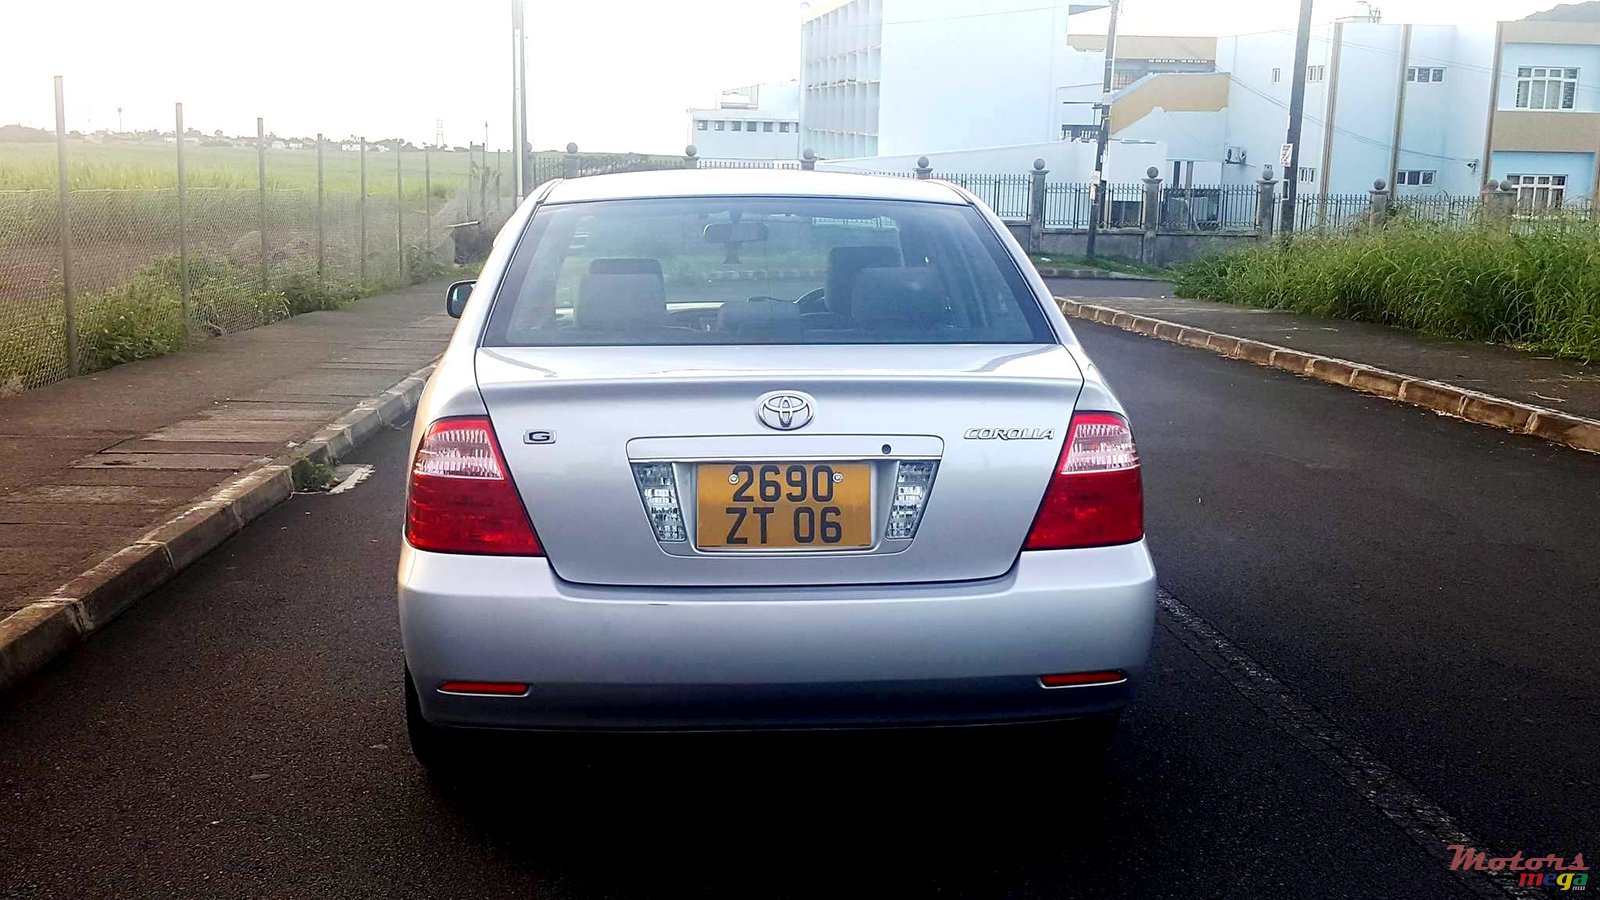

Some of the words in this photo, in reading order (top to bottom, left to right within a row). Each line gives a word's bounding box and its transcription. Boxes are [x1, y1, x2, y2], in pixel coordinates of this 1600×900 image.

[528, 431, 551, 442] G
[963, 427, 1055, 441] COROLLA
[732, 464, 834, 503] 2690
[725, 506, 775, 545] ZT
[793, 506, 843, 544] 06
